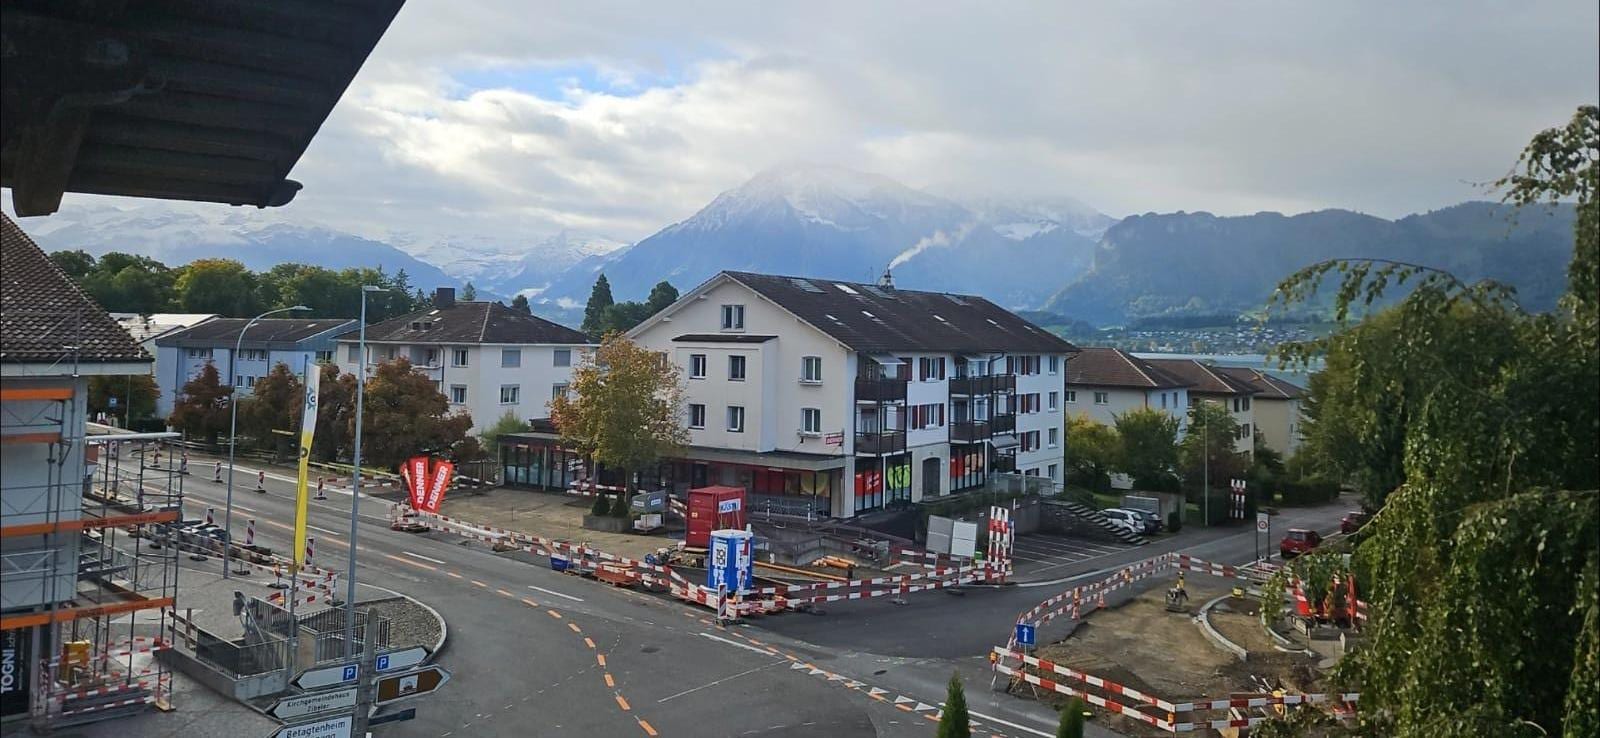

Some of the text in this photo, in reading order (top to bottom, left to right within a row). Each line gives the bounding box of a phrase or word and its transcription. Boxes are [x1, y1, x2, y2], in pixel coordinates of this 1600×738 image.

[415, 462, 425, 503] DENNER
[427, 466, 448, 509] DENNER
[1, 649, 15, 694] TOGNI
[286, 720, 346, 738] Betagtenheim
